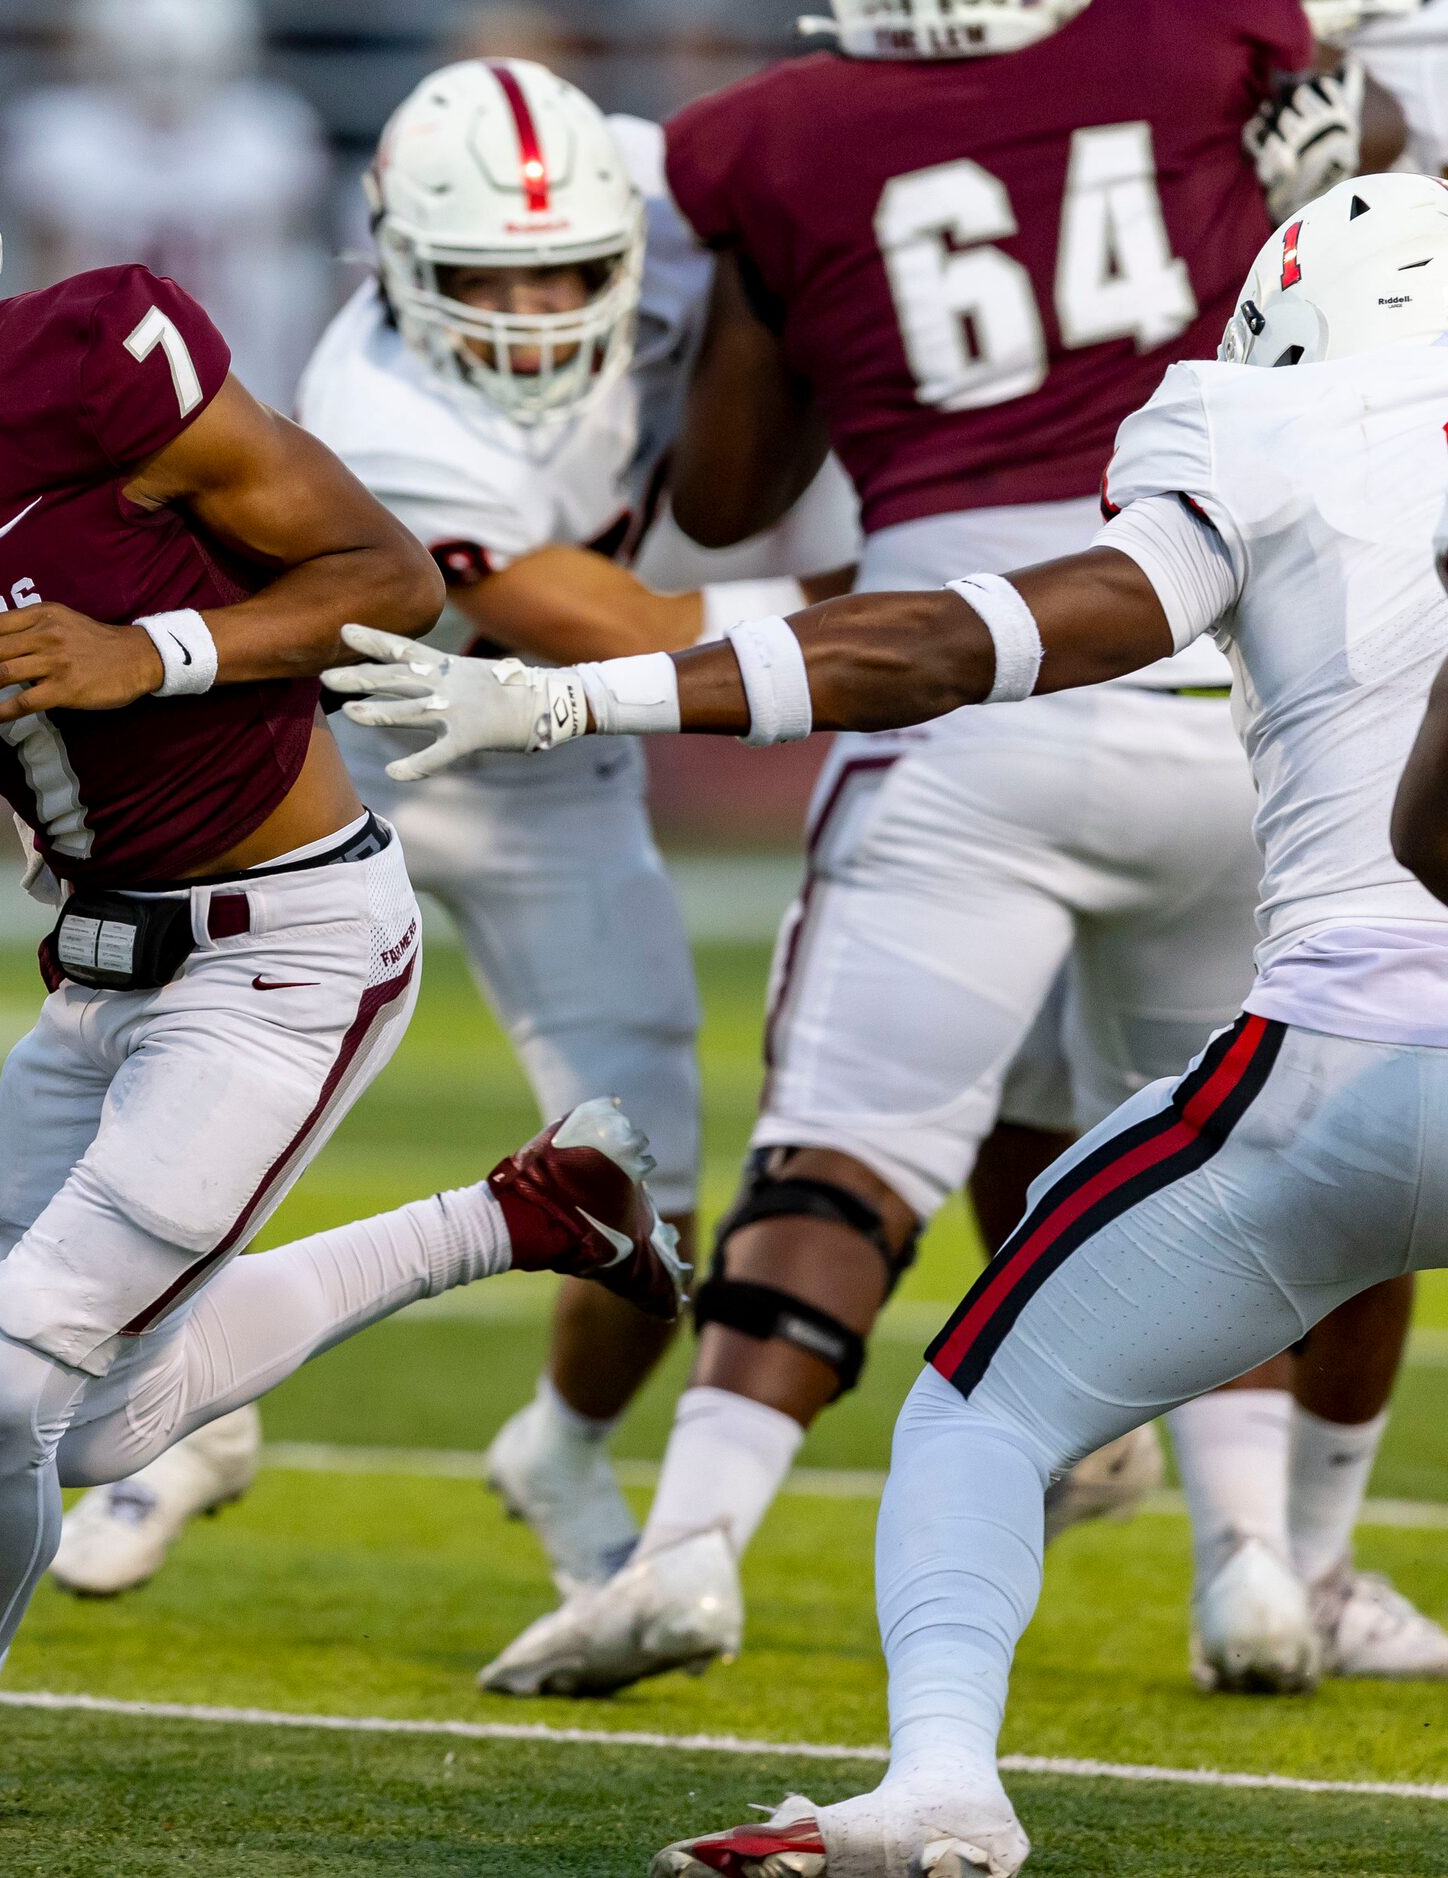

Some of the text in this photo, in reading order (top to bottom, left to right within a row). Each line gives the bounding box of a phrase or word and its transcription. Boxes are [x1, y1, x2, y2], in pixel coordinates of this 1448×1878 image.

[873, 120, 1198, 412] 64
[1280, 220, 1303, 292] 1
[1378, 295, 1411, 305] Riddell
[122, 304, 203, 419] 7
[379, 916, 417, 968] FARMERS
